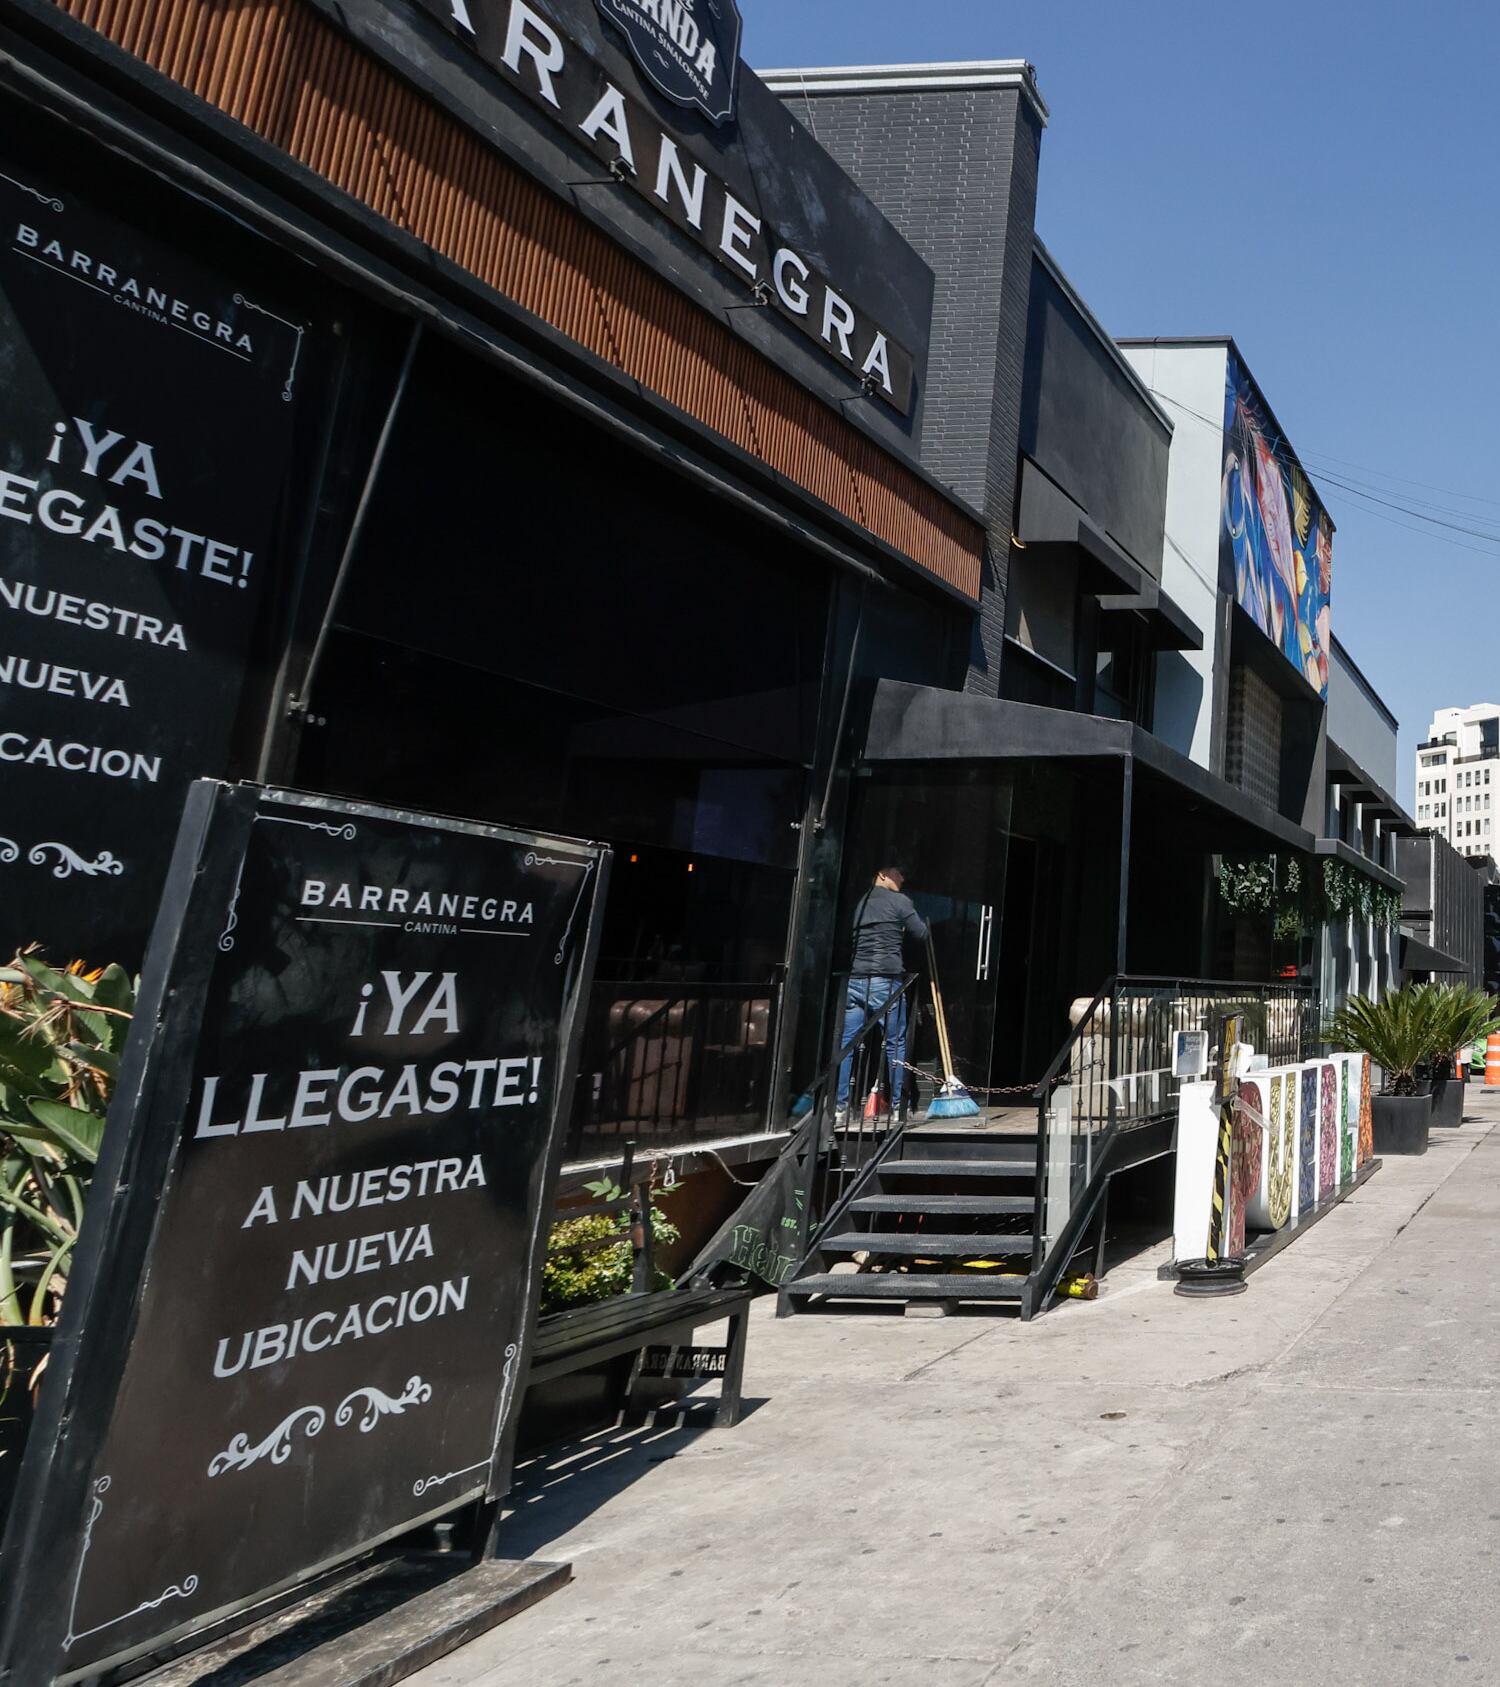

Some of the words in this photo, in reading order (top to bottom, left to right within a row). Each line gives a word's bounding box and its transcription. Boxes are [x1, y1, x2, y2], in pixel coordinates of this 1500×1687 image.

[658, 32, 709, 100] SINALOENSE
[15, 223, 253, 353] BARRANEGRA
[112, 294, 169, 325] CANTINA
[46, 416, 163, 500] ¡YA
[300, 879, 535, 924] BARRANEGRA
[404, 921, 458, 936] CANTINA
[350, 970, 460, 1037] ¡YA
[194, 1056, 543, 1139] LLEGASTE!
[241, 1185, 278, 1229] A
[289, 1154, 487, 1221] NUESTRA
[285, 1224, 434, 1291] NUEVA
[213, 1276, 470, 1378] UBICACION
